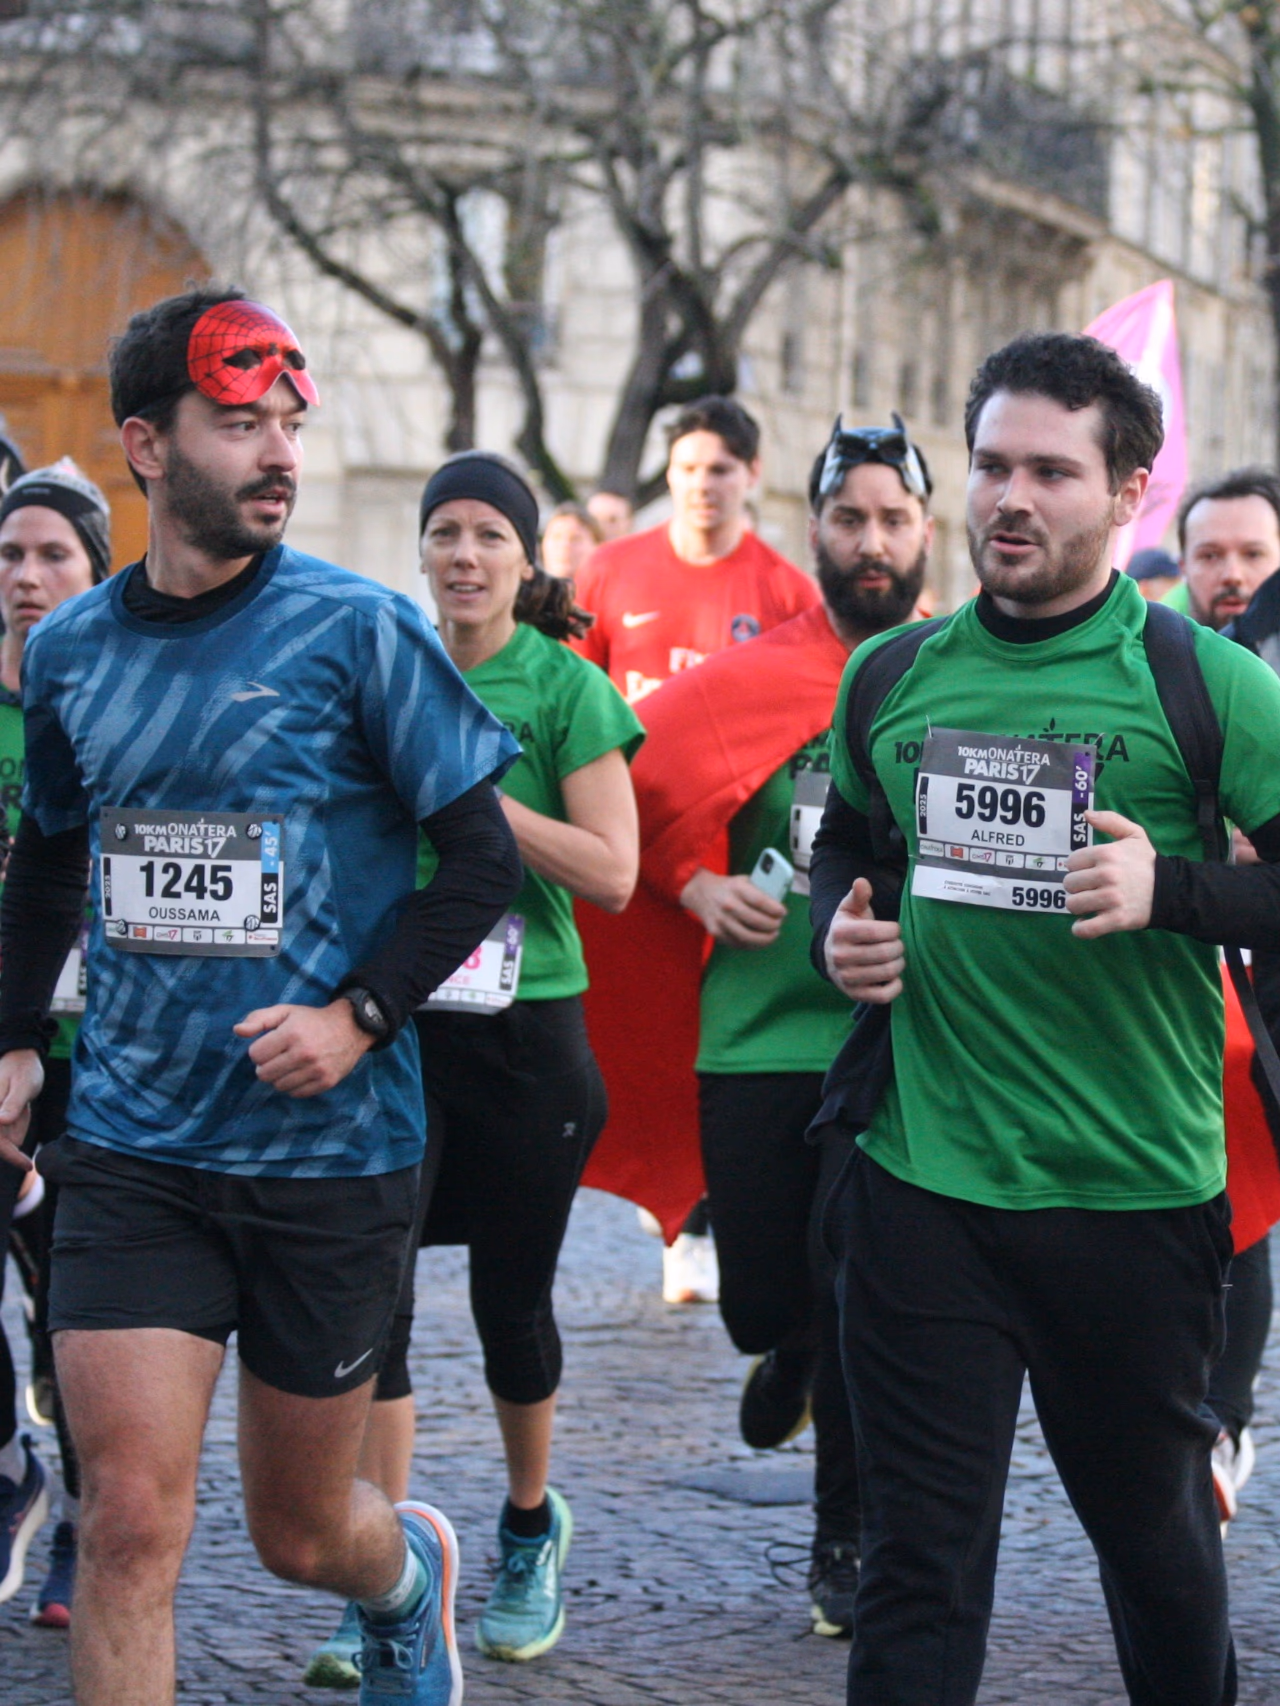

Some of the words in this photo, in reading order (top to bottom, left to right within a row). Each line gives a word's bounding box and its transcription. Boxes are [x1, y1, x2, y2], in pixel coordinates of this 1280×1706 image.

[919, 793, 928, 817] 2025
[955, 782, 1046, 828] 5996
[971, 829, 1026, 847] ALFRED
[1073, 813, 1087, 843] SAS
[139, 860, 234, 902] 1245
[263, 882, 278, 914] SAS
[1011, 886, 1066, 909] 5996
[148, 906, 221, 922] OUSSAMA
[501, 960, 513, 985] SAS
